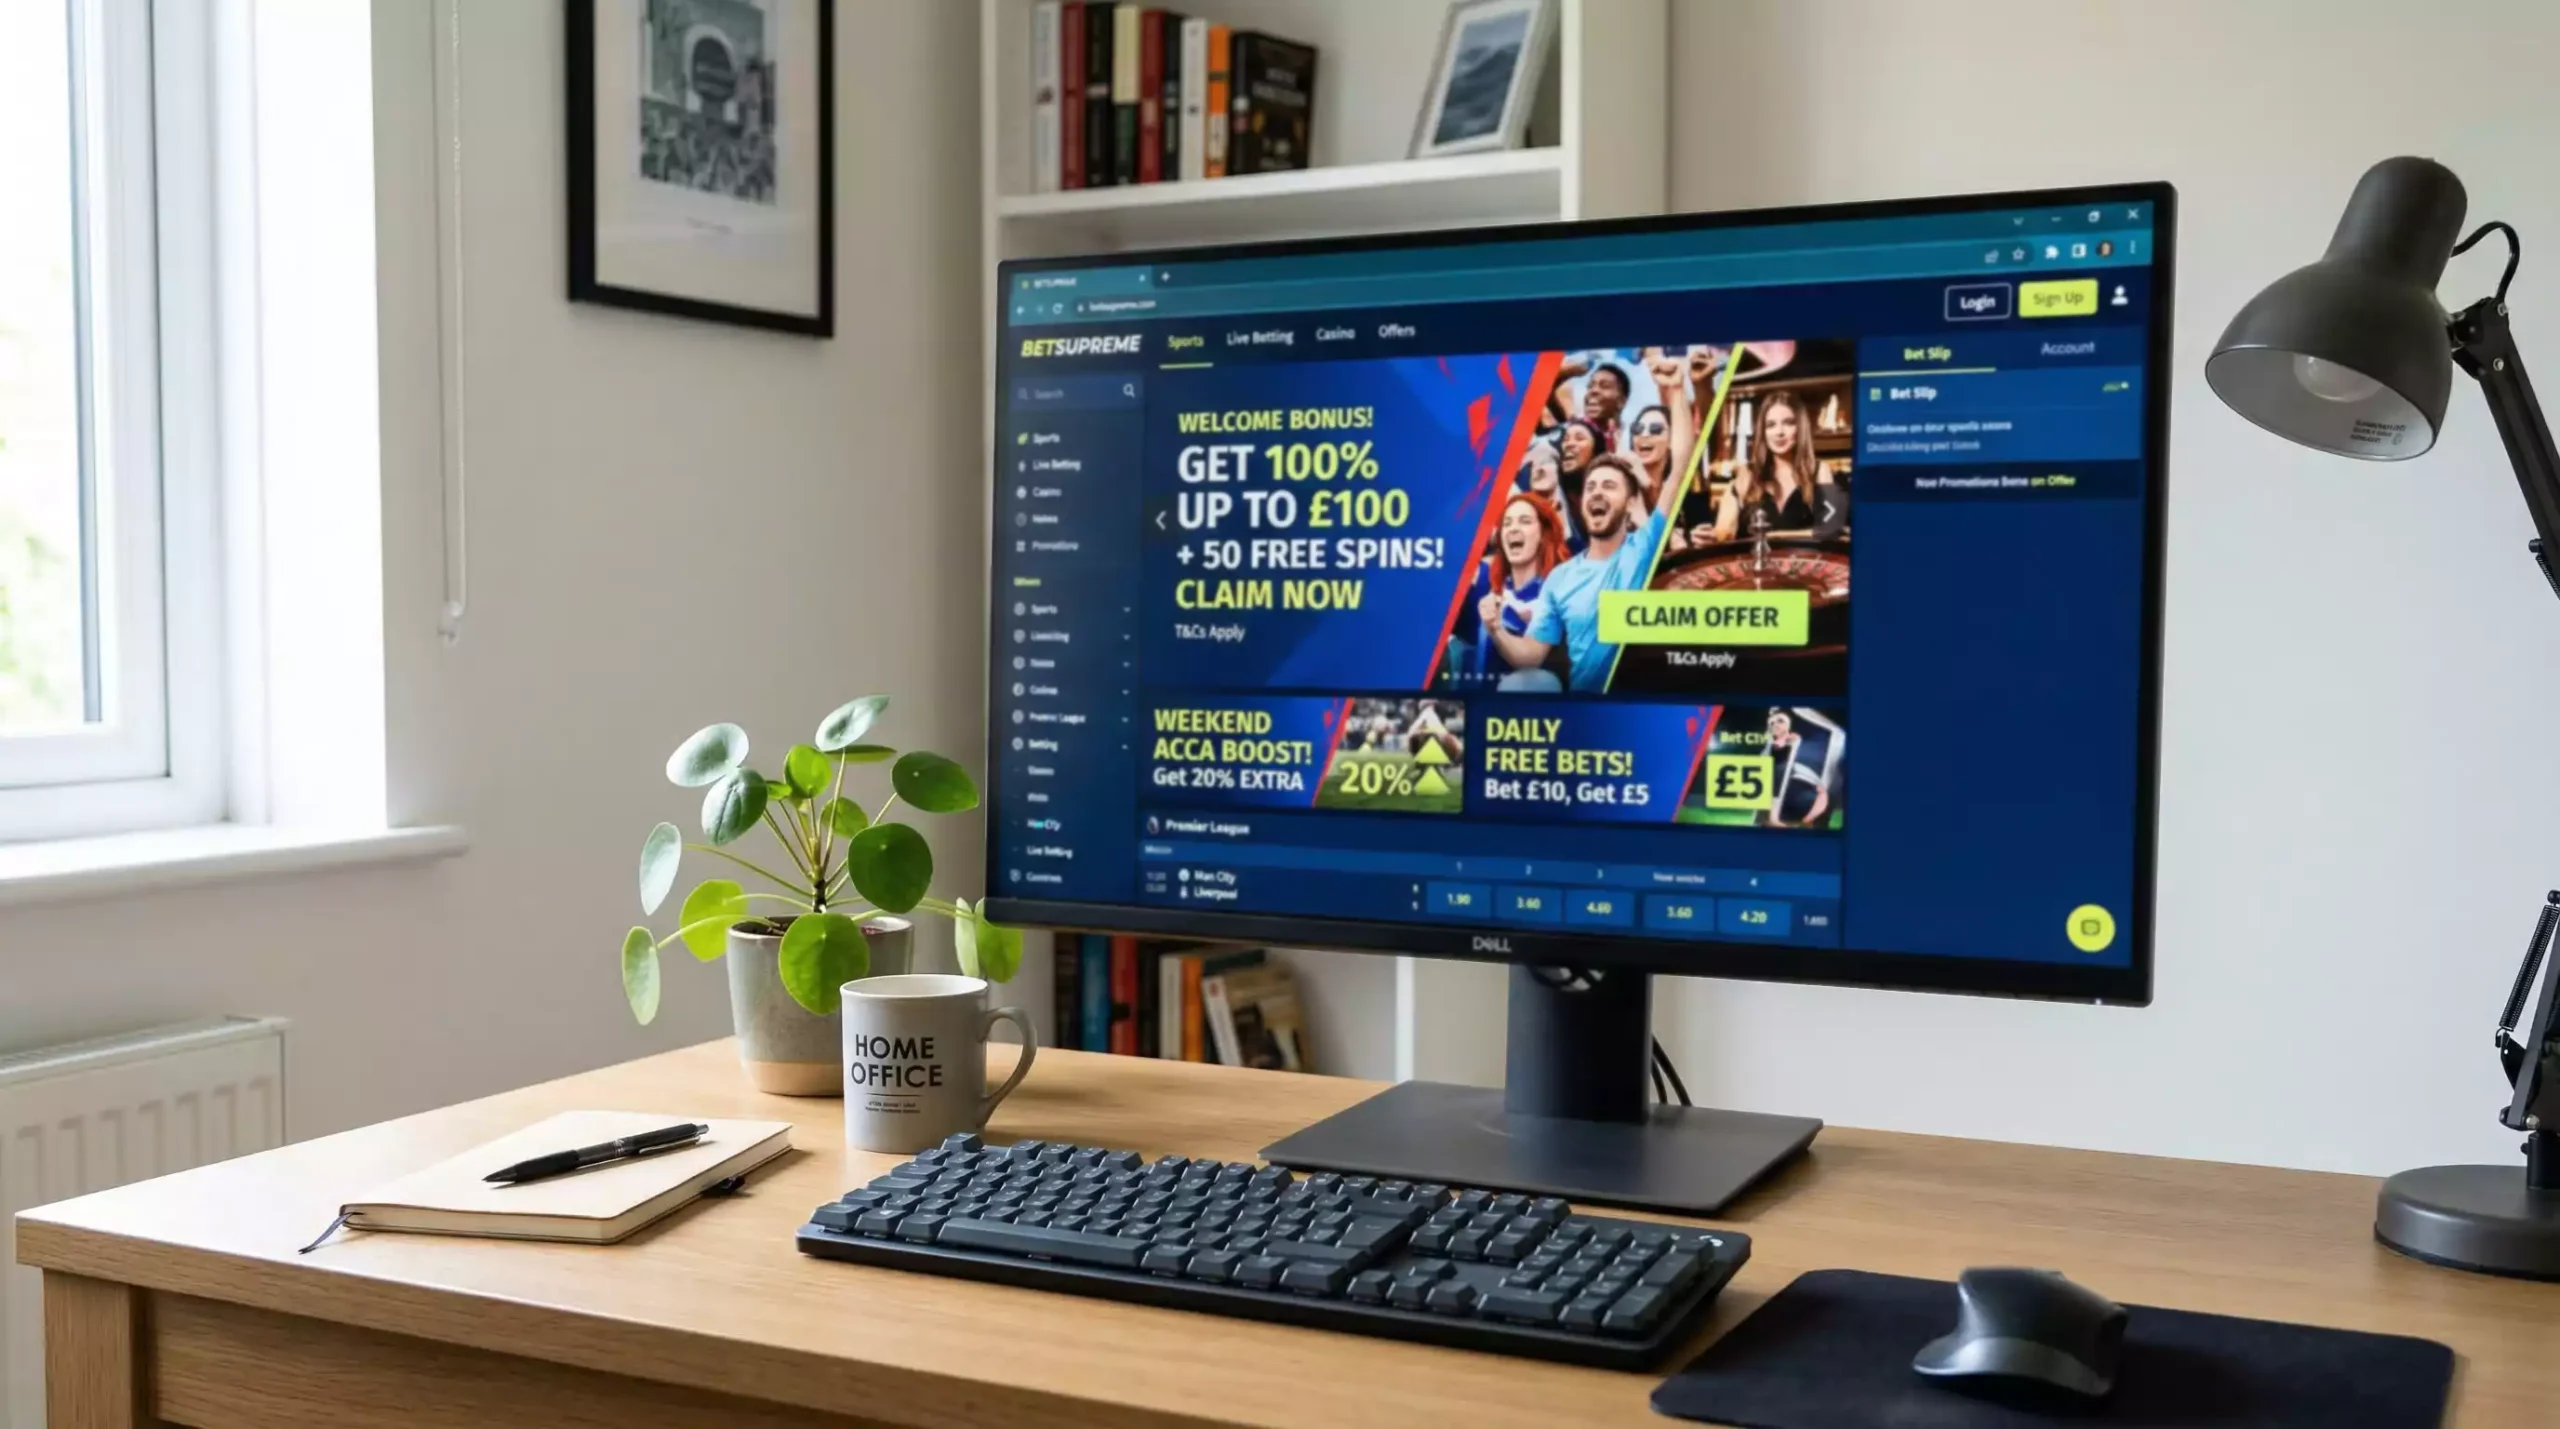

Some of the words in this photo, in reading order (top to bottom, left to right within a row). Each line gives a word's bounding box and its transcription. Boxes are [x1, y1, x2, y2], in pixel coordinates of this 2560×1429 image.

[1960, 295, 1996, 312] Login
[2033, 292, 2061, 309] Sign
[2064, 291, 2084, 307] Up
[1227, 330, 1248, 346] Live
[1252, 328, 1294, 348] Betting
[1315, 325, 1356, 342] Casino
[1378, 322, 1416, 339] Offers
[1020, 334, 1142, 357] BETSUPREME
[1168, 333, 1204, 350] Sports
[2041, 341, 2095, 356] Account
[1903, 348, 1925, 361] Bet
[1927, 346, 1952, 363] Slip
[1890, 387, 1913, 400] Bet
[1914, 385, 1937, 401] Slip
[1178, 409, 1283, 434] WELCOME
[1289, 406, 1374, 430] BONUS!
[1177, 444, 1255, 483] GET
[1264, 440, 1379, 481] 100%
[1177, 491, 1233, 529] UP
[1242, 489, 1297, 528] TO
[1308, 488, 1410, 528] £100
[1176, 545, 1194, 566] +
[1202, 540, 1241, 569] 50
[1250, 538, 1327, 569] FREE
[1335, 537, 1445, 569] SPINS!
[1175, 579, 1273, 610] CLAIM
[1283, 579, 1363, 610] NOW
[1625, 605, 1697, 628] CLAIM
[1704, 606, 1780, 628] OFFER
[1174, 624, 1206, 639] T&Cs
[1208, 625, 1246, 642] Apply
[1666, 651, 1698, 666] T&Cs
[1700, 651, 1737, 669] Apply
[1154, 708, 1272, 735] WEEKEND
[1486, 717, 1562, 744] DAILY
[1153, 737, 1216, 761] ACCA
[1222, 738, 1312, 765] BOOST!
[1485, 747, 1550, 774] FREE
[1556, 748, 1634, 778] BETS!
[1153, 766, 1187, 787] Get
[1191, 767, 1235, 789] 20%
[1240, 768, 1304, 791] EXTRA
[1338, 761, 1412, 796] 20%
[1714, 764, 1763, 800] £5
[1485, 778, 1521, 800] Bet
[1526, 779, 1571, 807] £10,
[1576, 781, 1616, 804] Get
[1621, 783, 1650, 806] £5
[1165, 818, 1208, 833] Premier
[1210, 820, 1250, 836] League
[1194, 870, 1215, 881] Man
[1216, 871, 1236, 886] City
[1194, 885, 1238, 902] Liverpool
[1667, 905, 1693, 920] 3.60
[1740, 910, 1768, 924] 4.20
[1472, 936, 1512, 953] DELL
[855, 1034, 935, 1060] HOME
[851, 1062, 943, 1088] OFFICE
